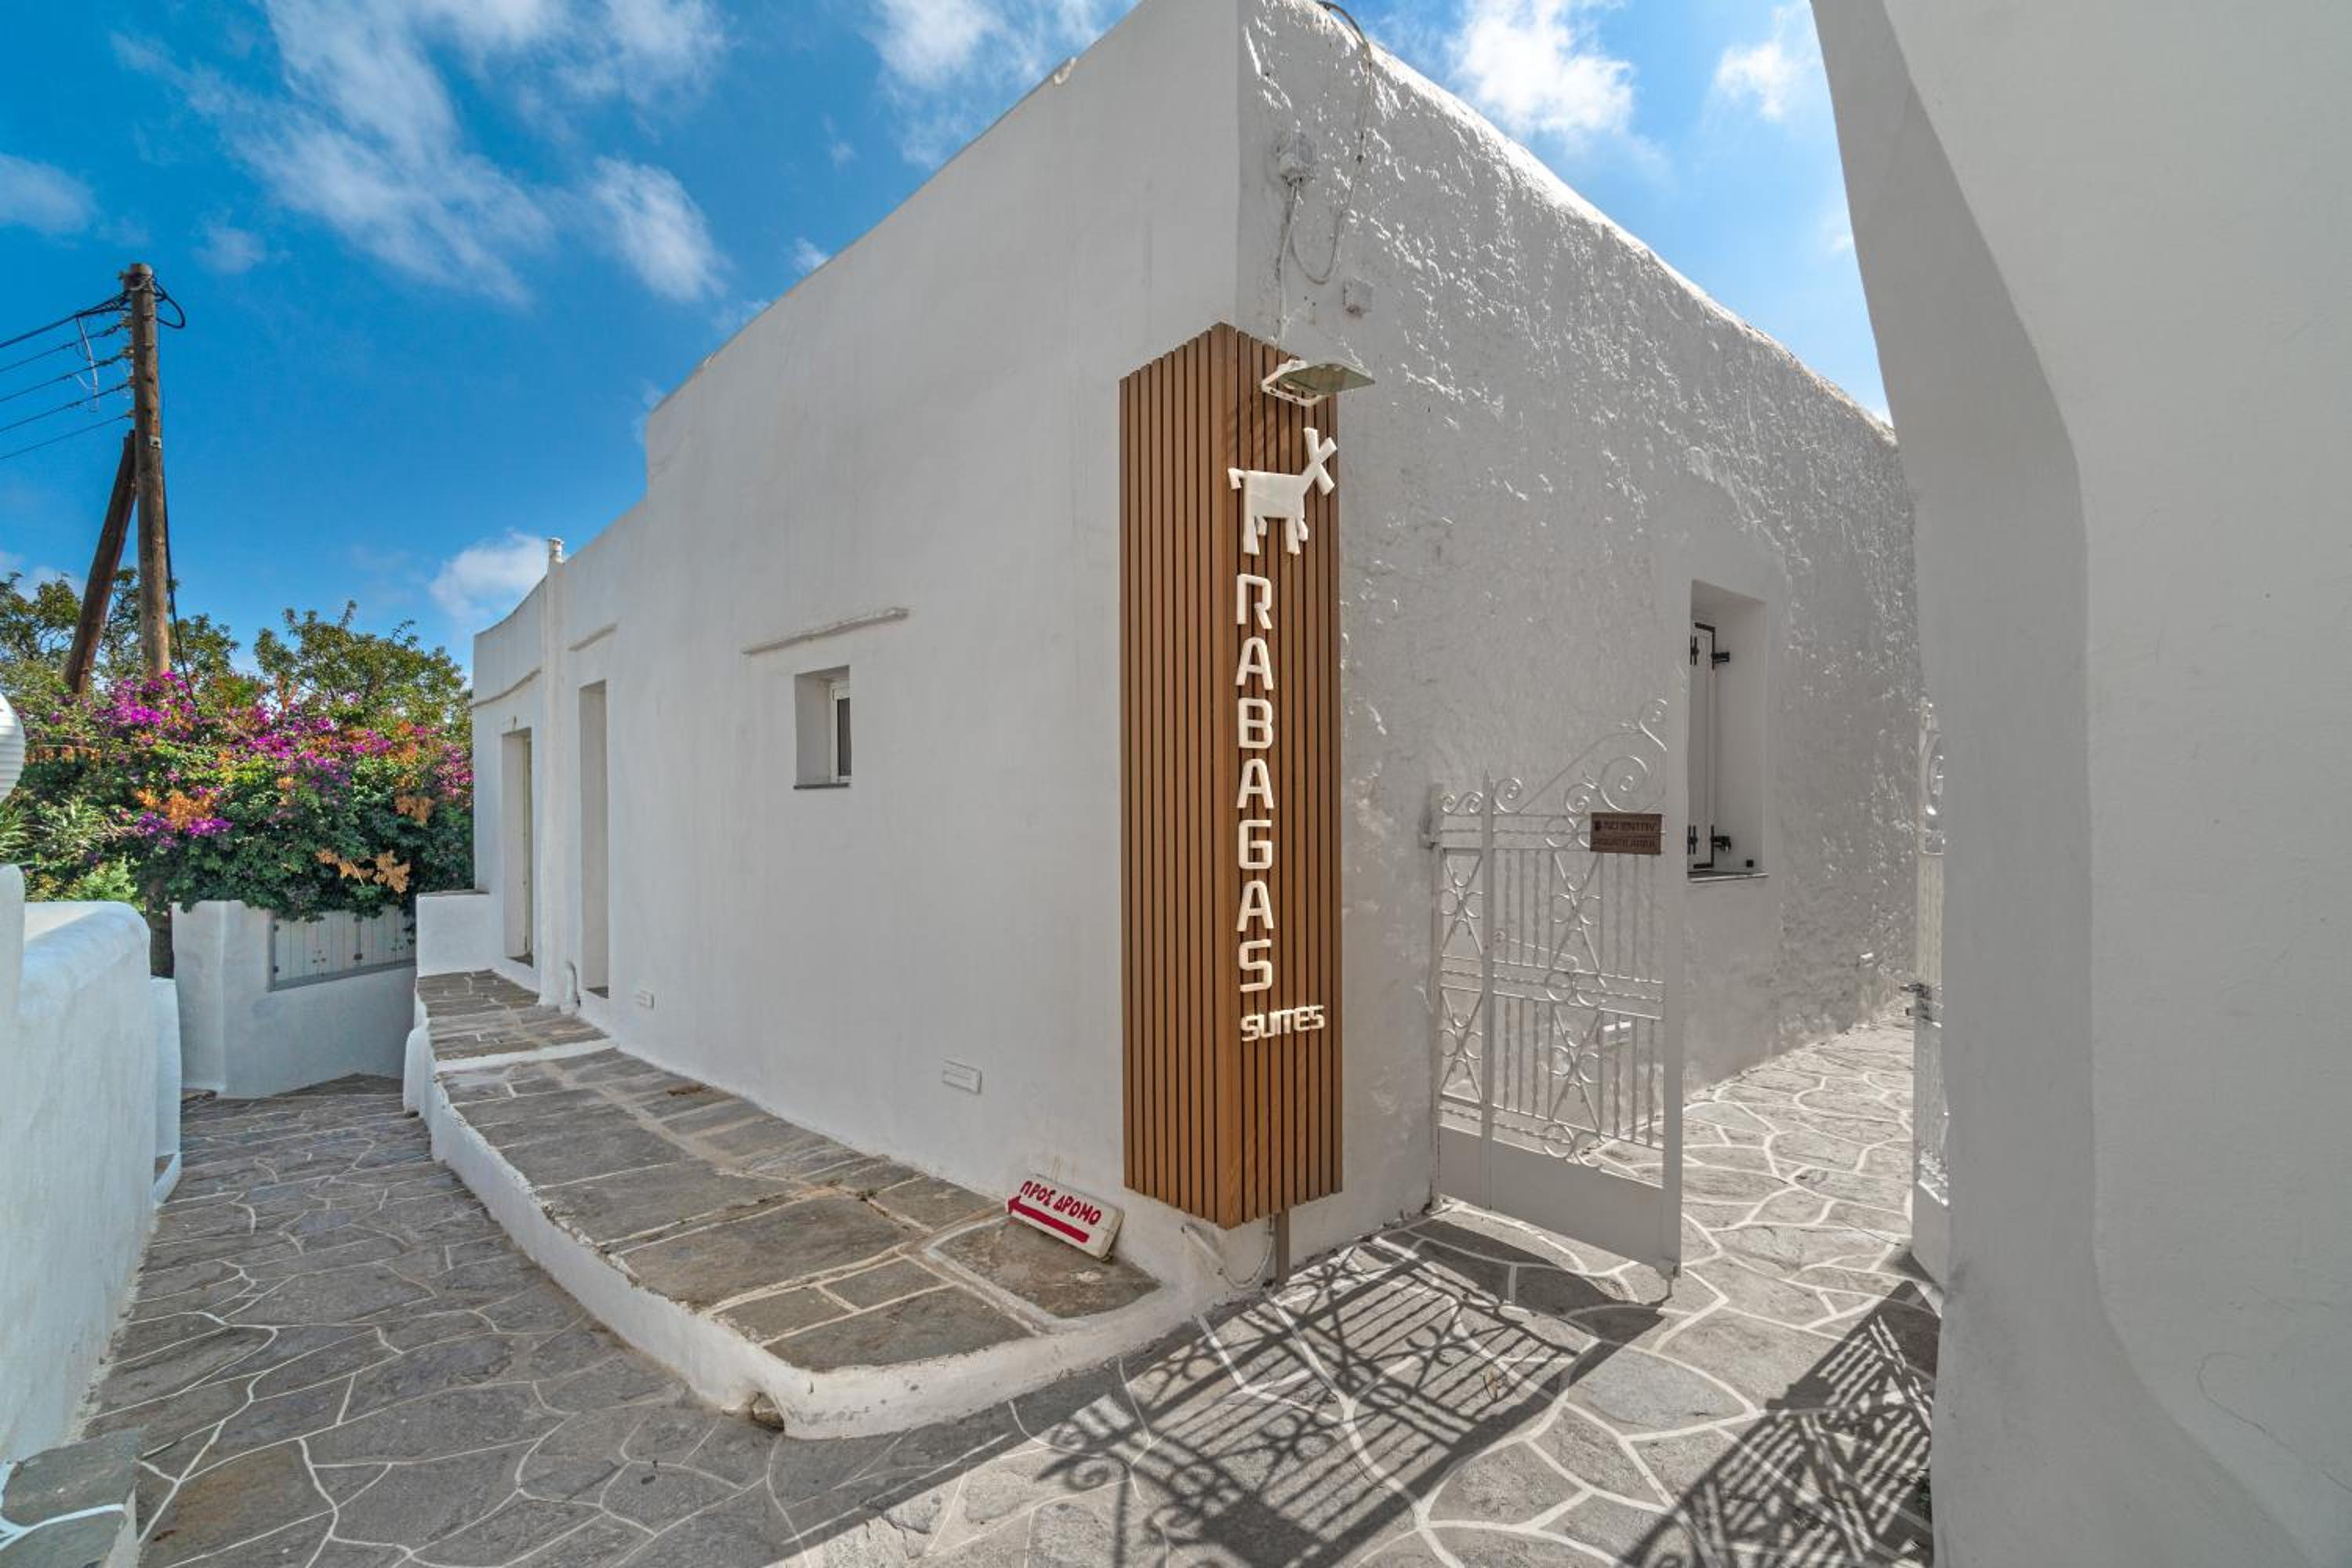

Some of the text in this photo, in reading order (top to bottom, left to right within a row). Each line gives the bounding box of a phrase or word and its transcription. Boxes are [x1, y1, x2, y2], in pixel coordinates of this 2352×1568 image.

[1235, 573, 1274, 993] RABAGAS
[1240, 1004, 1325, 1042] SUITES
[1020, 1180, 1102, 1225] ΠΡΟΣ ΔΡΟΜΟ
